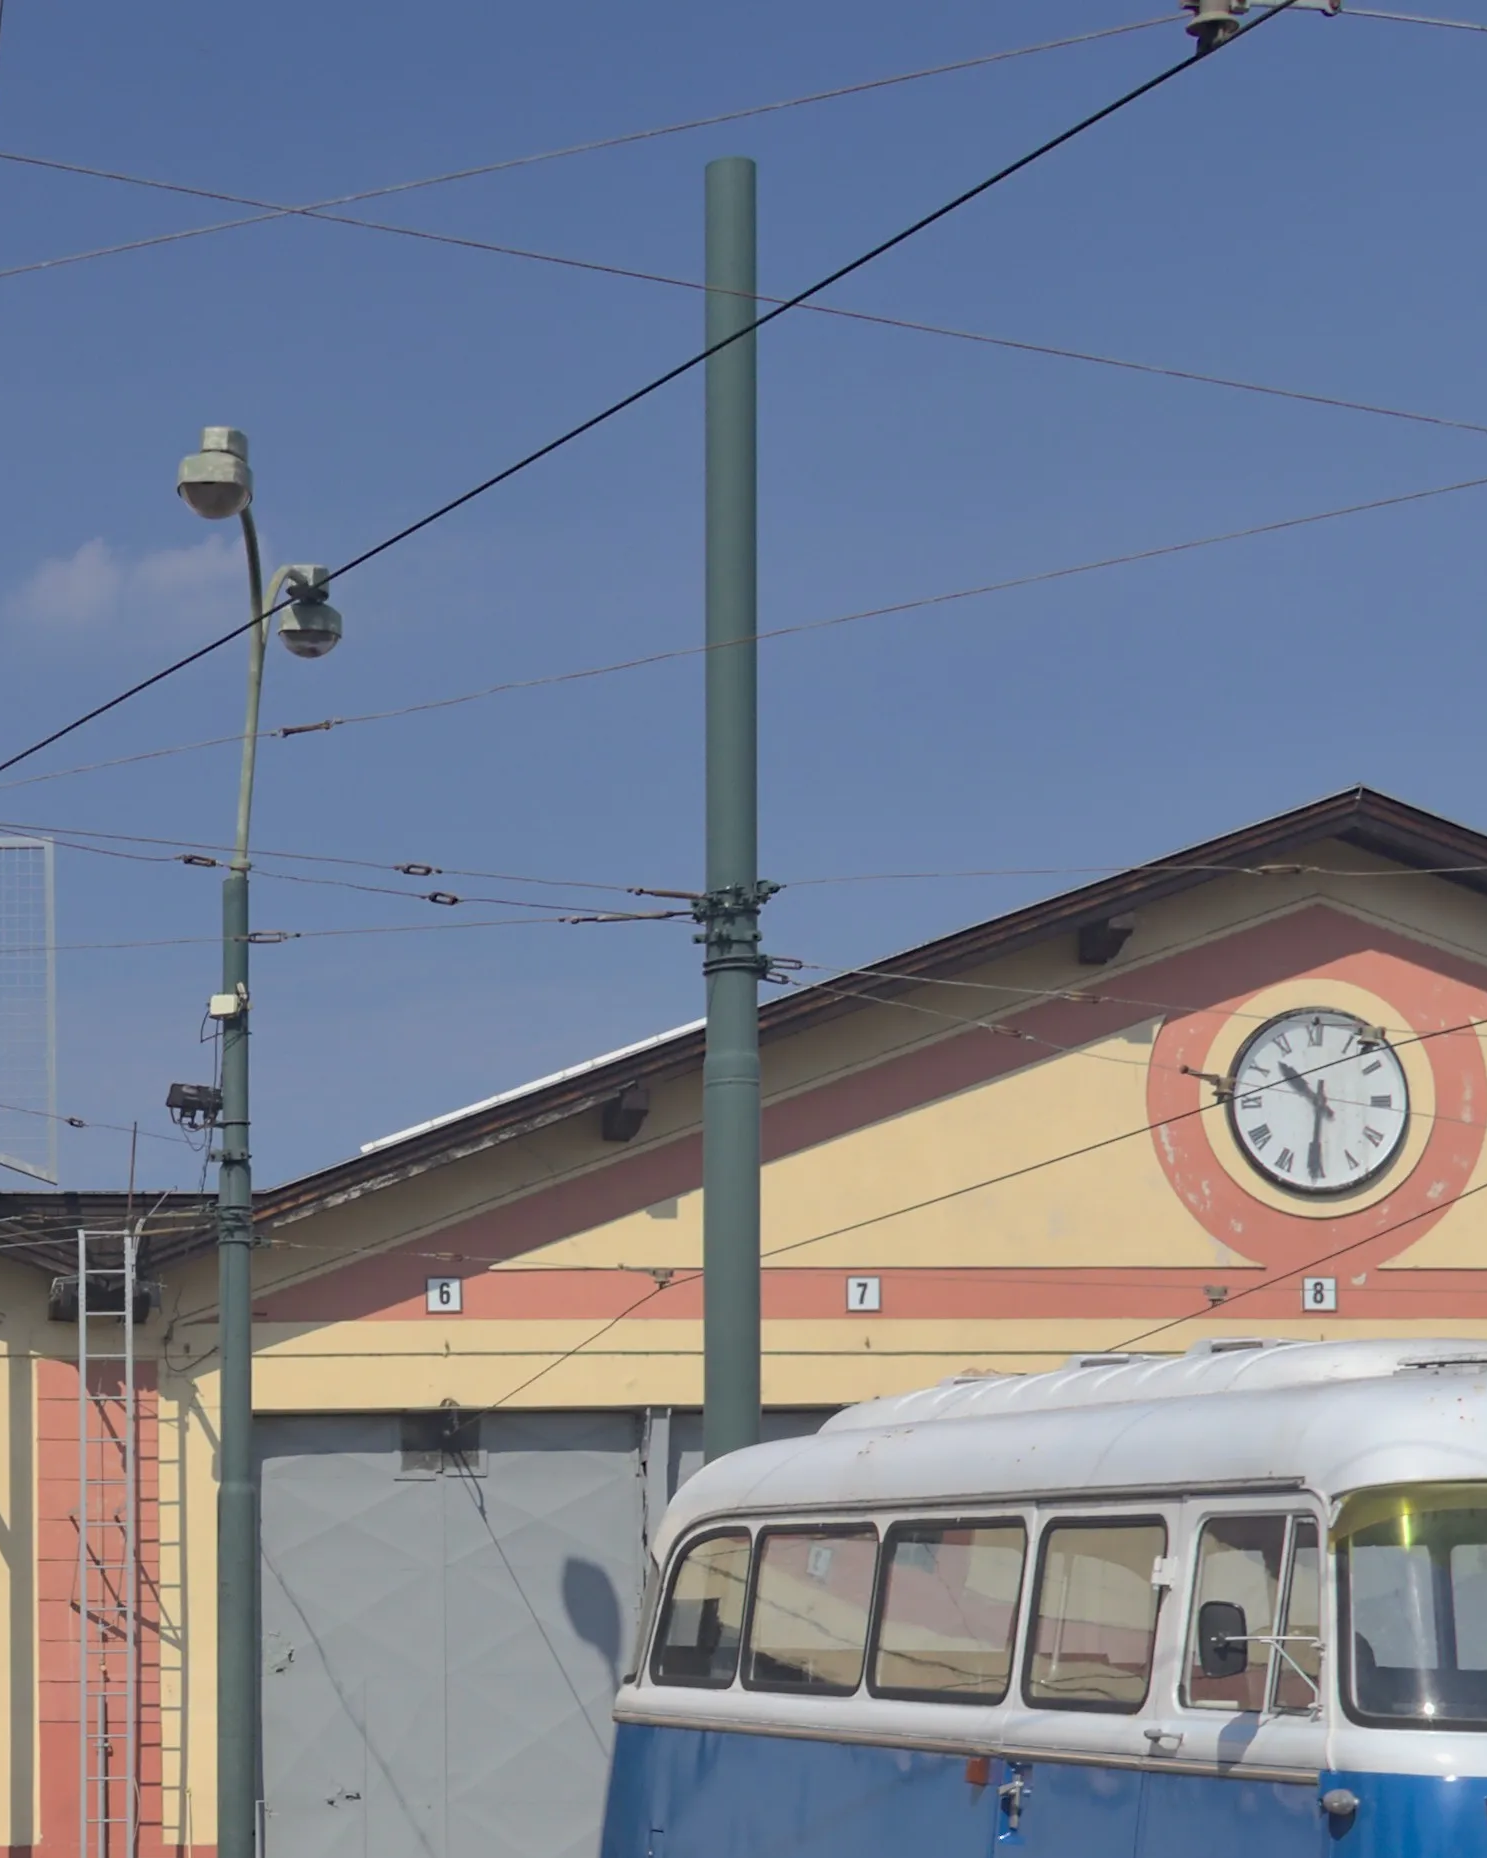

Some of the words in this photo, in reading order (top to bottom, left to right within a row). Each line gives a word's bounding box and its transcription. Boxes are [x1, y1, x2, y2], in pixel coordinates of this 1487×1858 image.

[439, 1283, 451, 1304] 6
[856, 1283, 868, 1304] 7
[1313, 1282, 1325, 1303] 8
